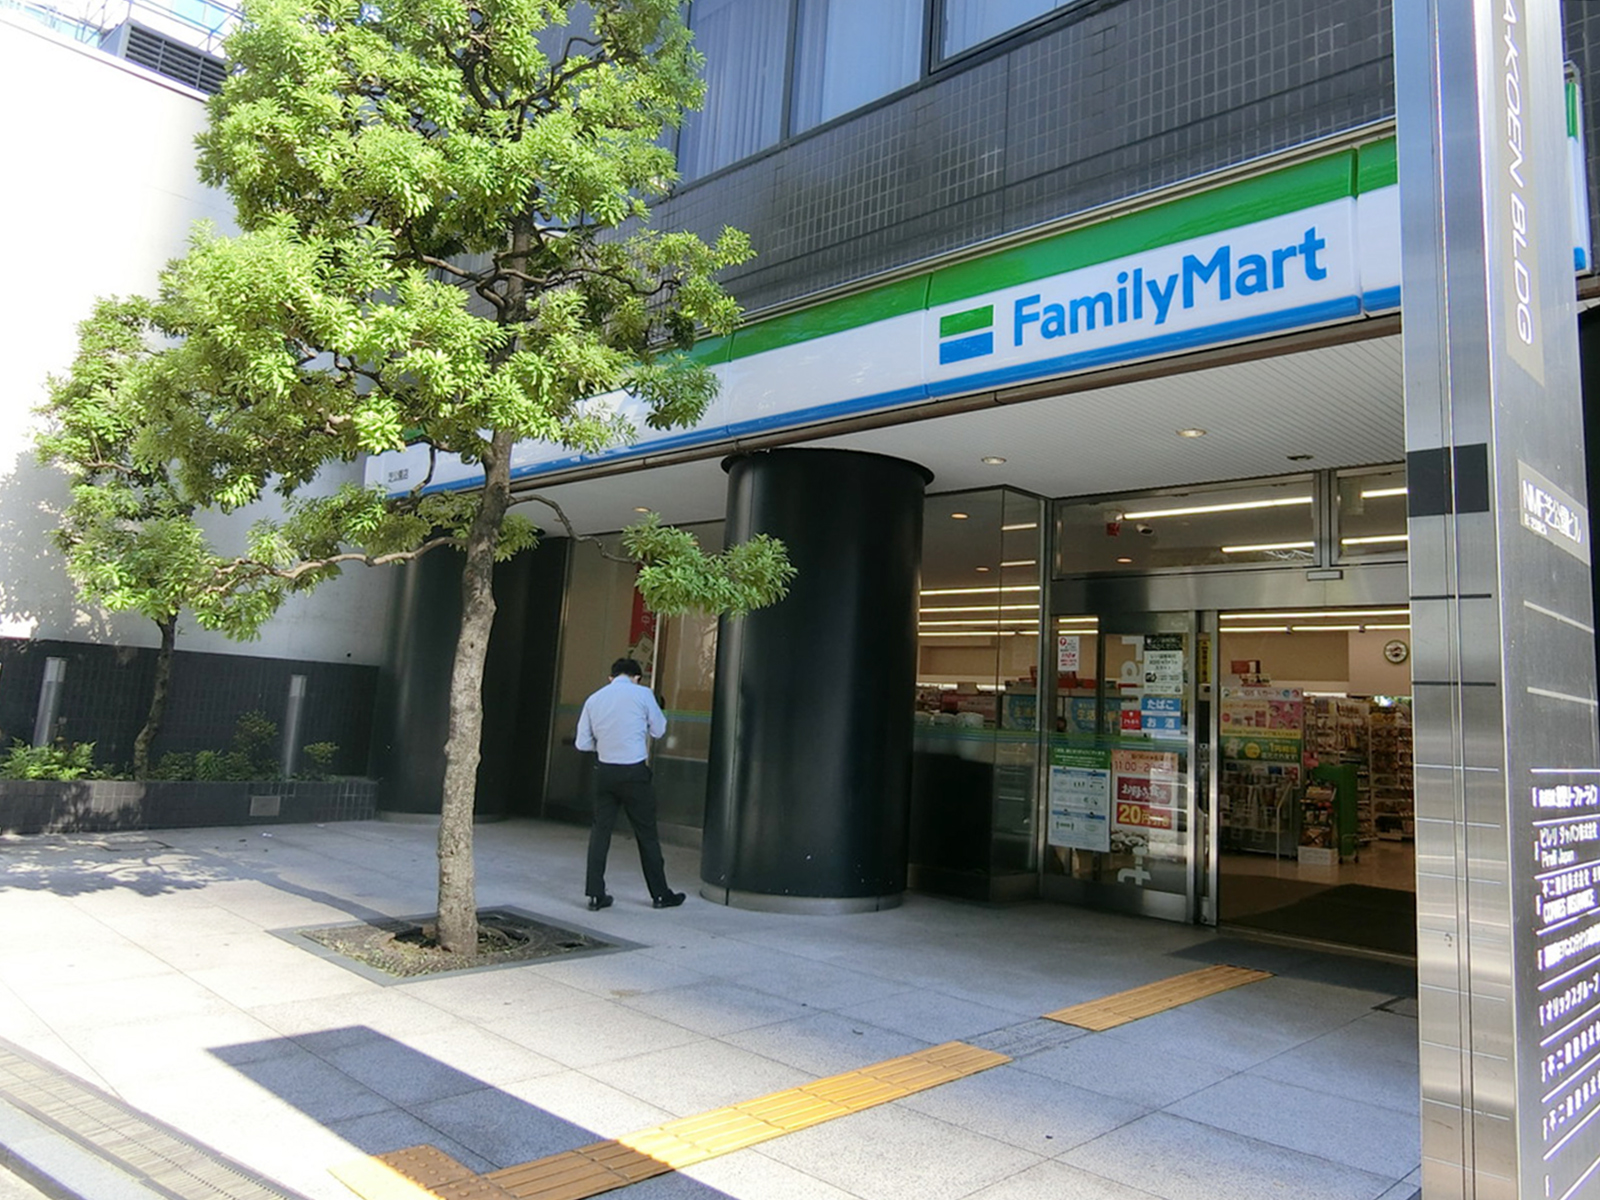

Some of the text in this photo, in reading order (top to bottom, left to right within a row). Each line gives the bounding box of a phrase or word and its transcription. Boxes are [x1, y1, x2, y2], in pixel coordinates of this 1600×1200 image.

[1013, 226, 1327, 347] FamilyMart
[1511, 193, 1532, 345] BLDG
[1147, 699, 1175, 710] たばこ
[1147, 716, 1175, 729] お酒
